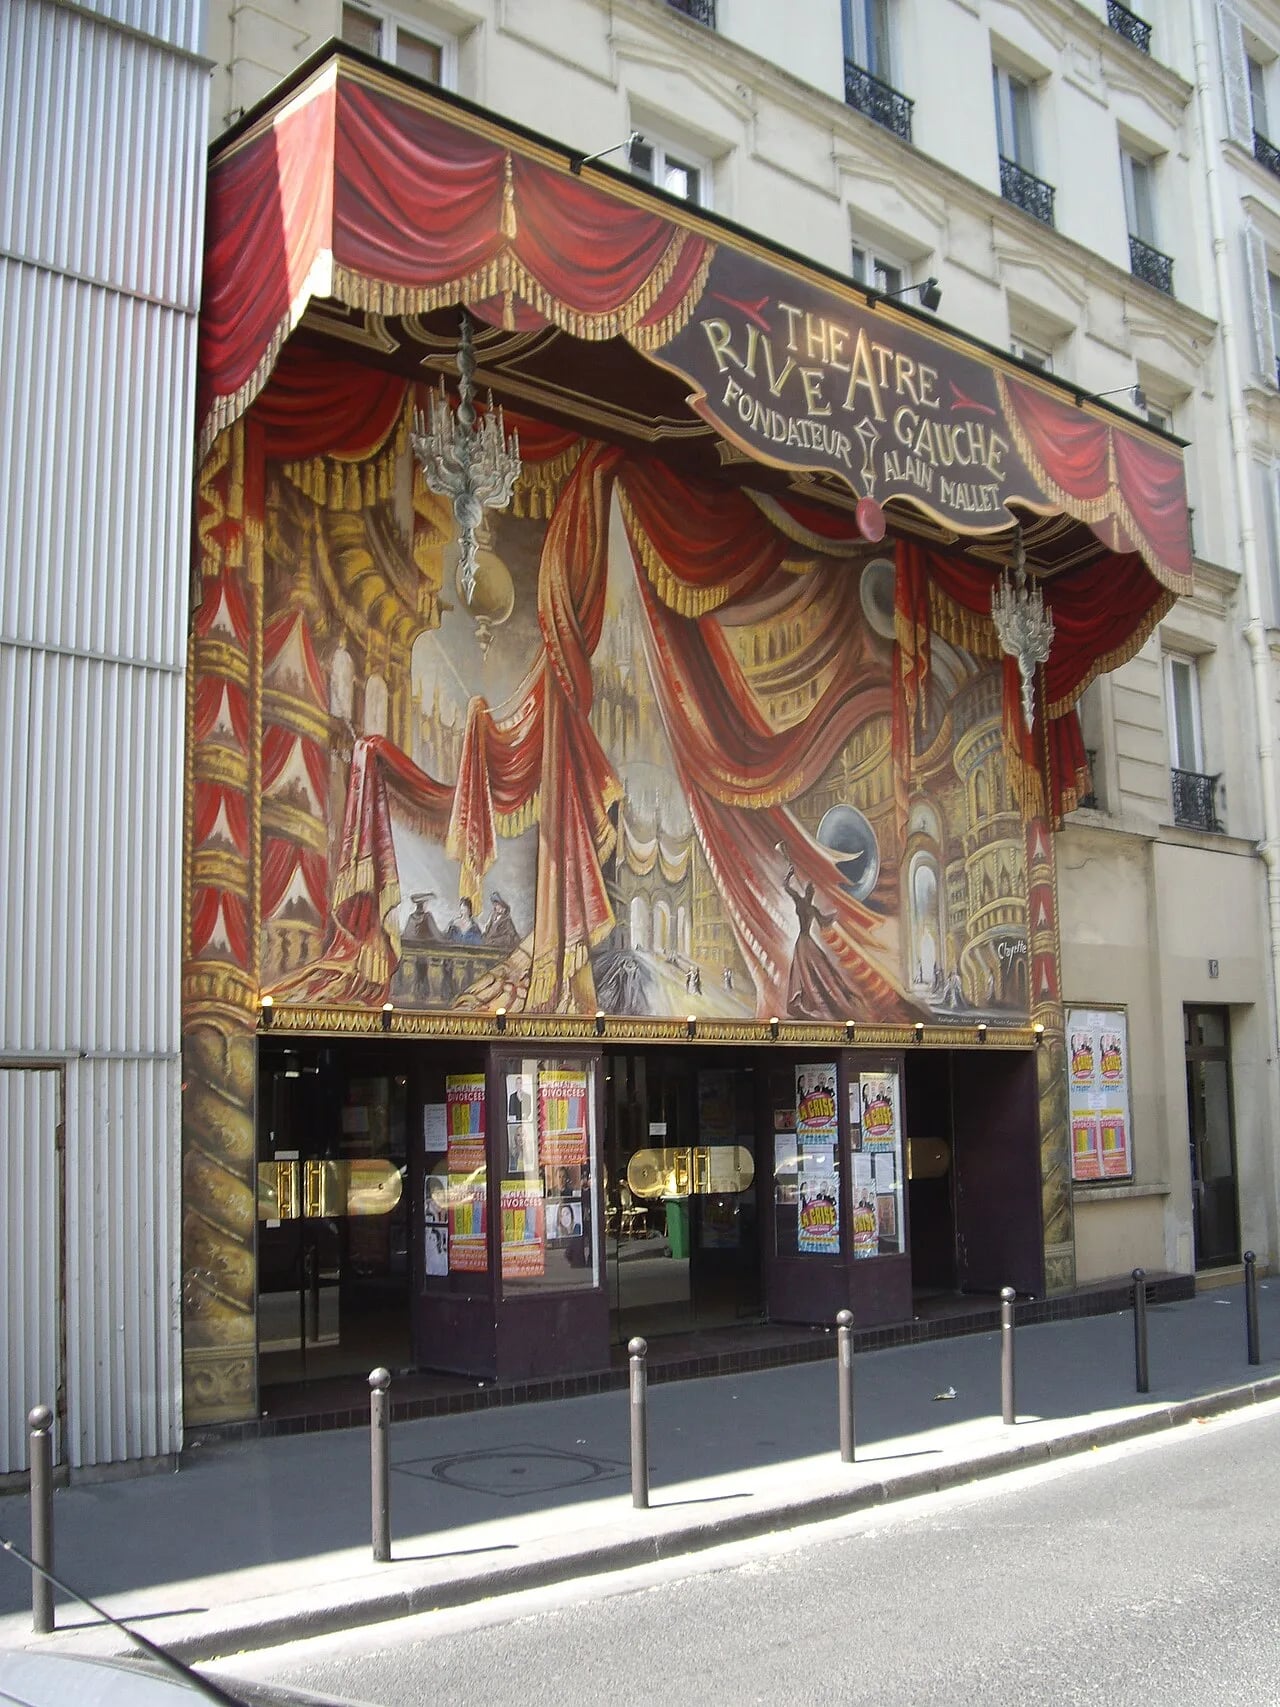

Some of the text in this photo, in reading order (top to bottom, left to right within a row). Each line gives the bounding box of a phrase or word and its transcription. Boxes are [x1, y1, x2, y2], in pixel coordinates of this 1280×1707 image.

[779, 301, 940, 422] THEATRE
[700, 317, 1009, 481] RIVE GAUCHE
[722, 376, 1001, 512] FONDATEUR ALAIN MALLET
[542, 1088, 585, 1097] DIVORCEES
[808, 1097, 834, 1117] CRISE
[810, 1206, 835, 1225] CRISE
